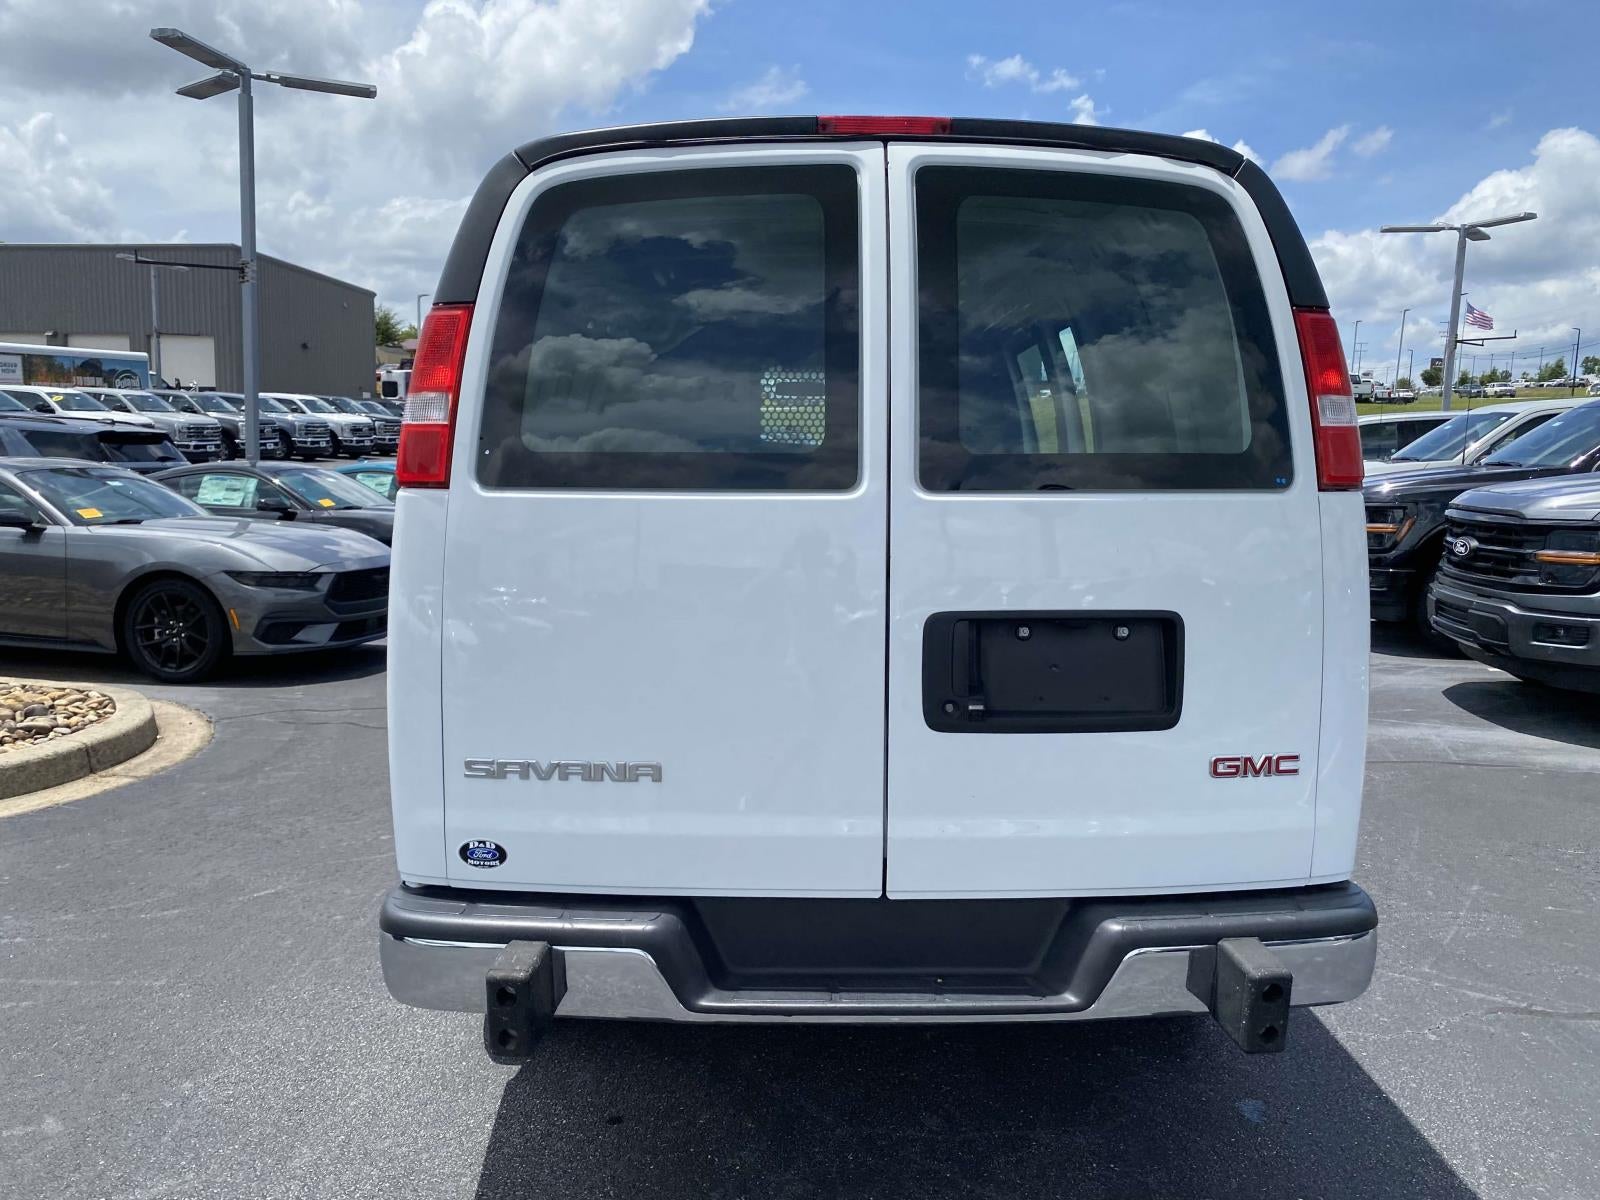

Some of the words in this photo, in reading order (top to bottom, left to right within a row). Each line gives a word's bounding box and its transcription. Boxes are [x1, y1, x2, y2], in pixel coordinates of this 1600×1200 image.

[464, 758, 662, 783] SAVANA
[1210, 754, 1300, 778] GMC
[473, 848, 493, 859] Ford
